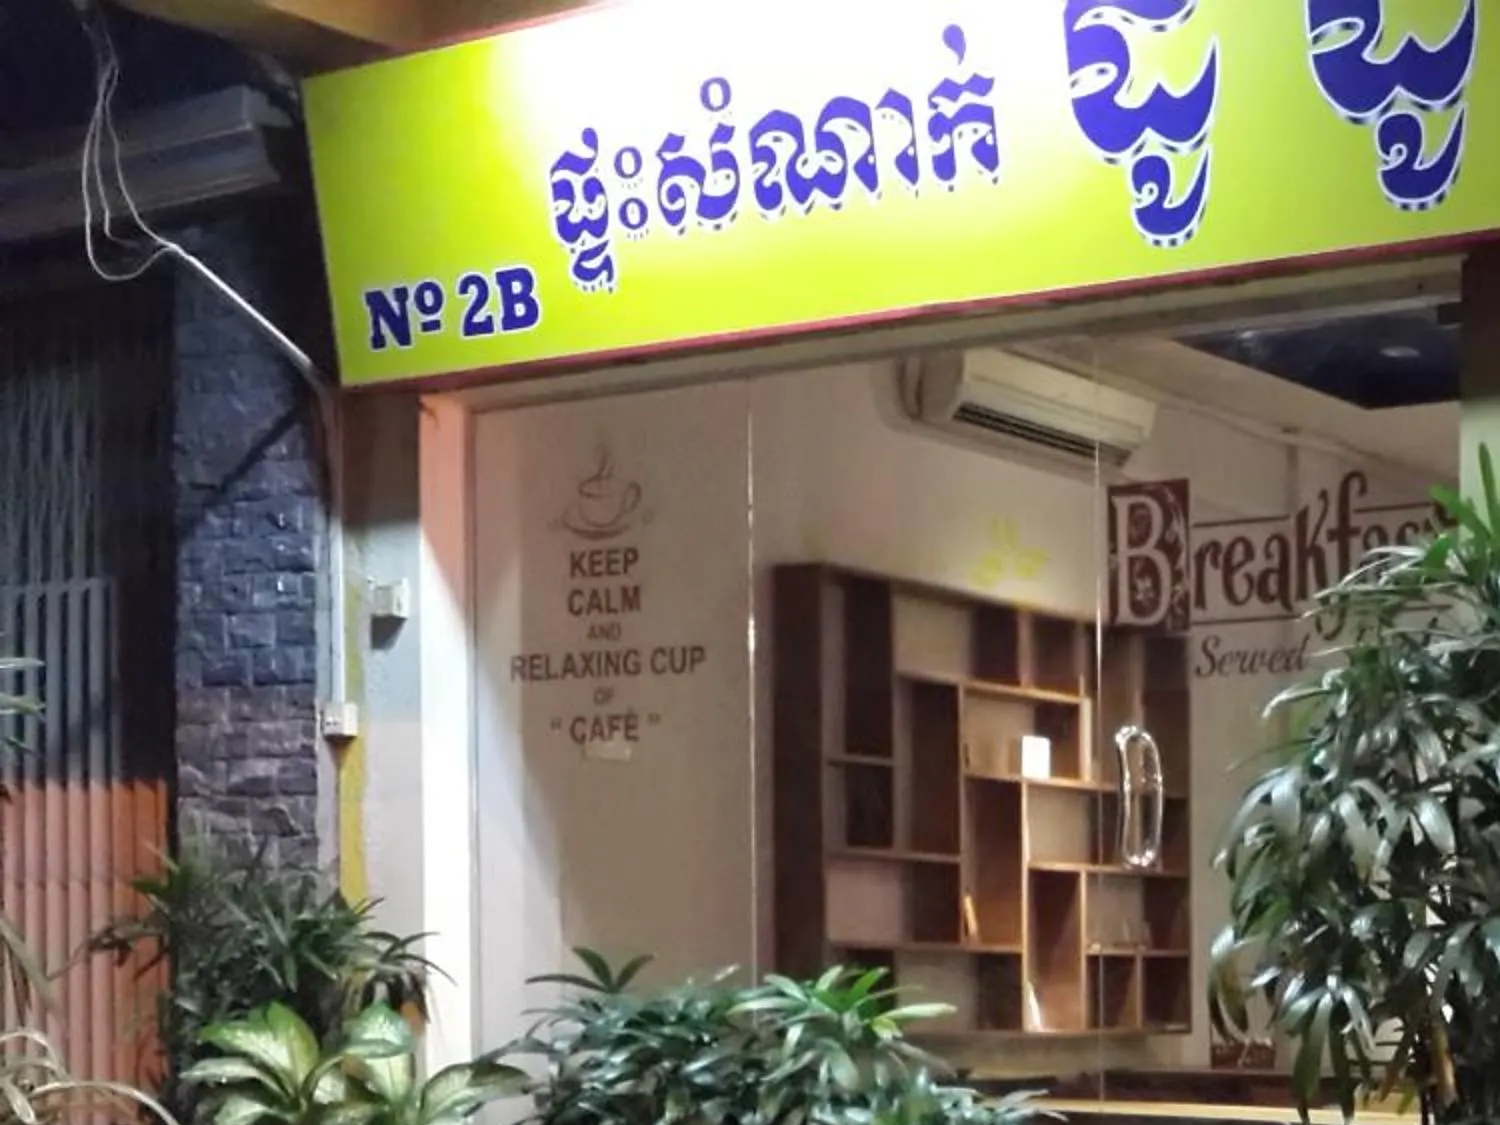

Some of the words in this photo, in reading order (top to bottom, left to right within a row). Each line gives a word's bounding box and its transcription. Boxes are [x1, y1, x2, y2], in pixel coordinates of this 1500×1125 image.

[548, 23, 1000, 286] ផ្ទះសំណាក់
[458, 266, 540, 337] 2B
[569, 548, 640, 579] KEEP
[1107, 471, 1458, 640] Breakfa
[567, 585, 642, 617] CALM
[586, 622, 622, 641] AND
[510, 649, 642, 683] RELAXING
[650, 646, 707, 676] CUP
[593, 686, 615, 705] OF
